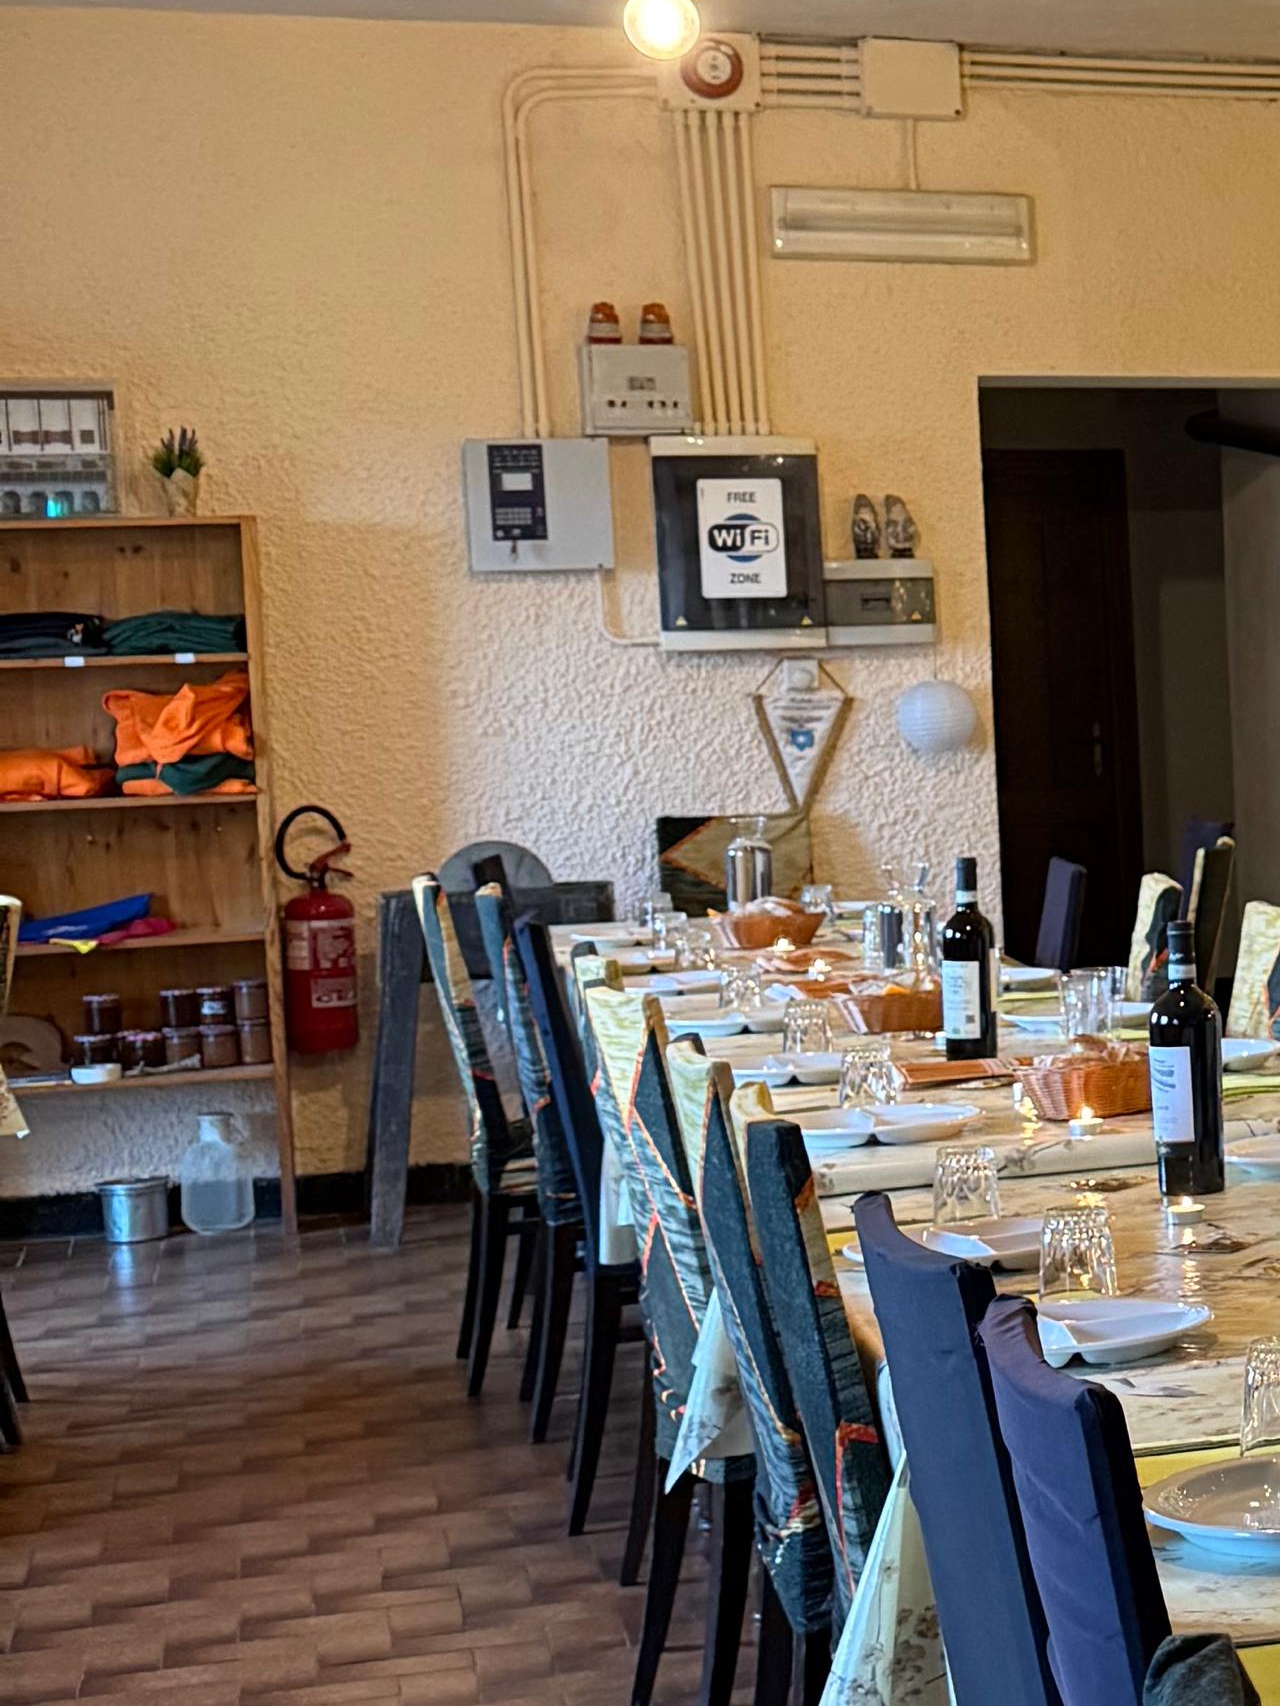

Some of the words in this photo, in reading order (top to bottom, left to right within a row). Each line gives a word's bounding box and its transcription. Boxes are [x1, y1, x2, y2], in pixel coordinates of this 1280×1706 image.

[727, 492, 756, 503] FREE
[712, 528, 769, 547] WiFi
[730, 572, 761, 584] ZONE
